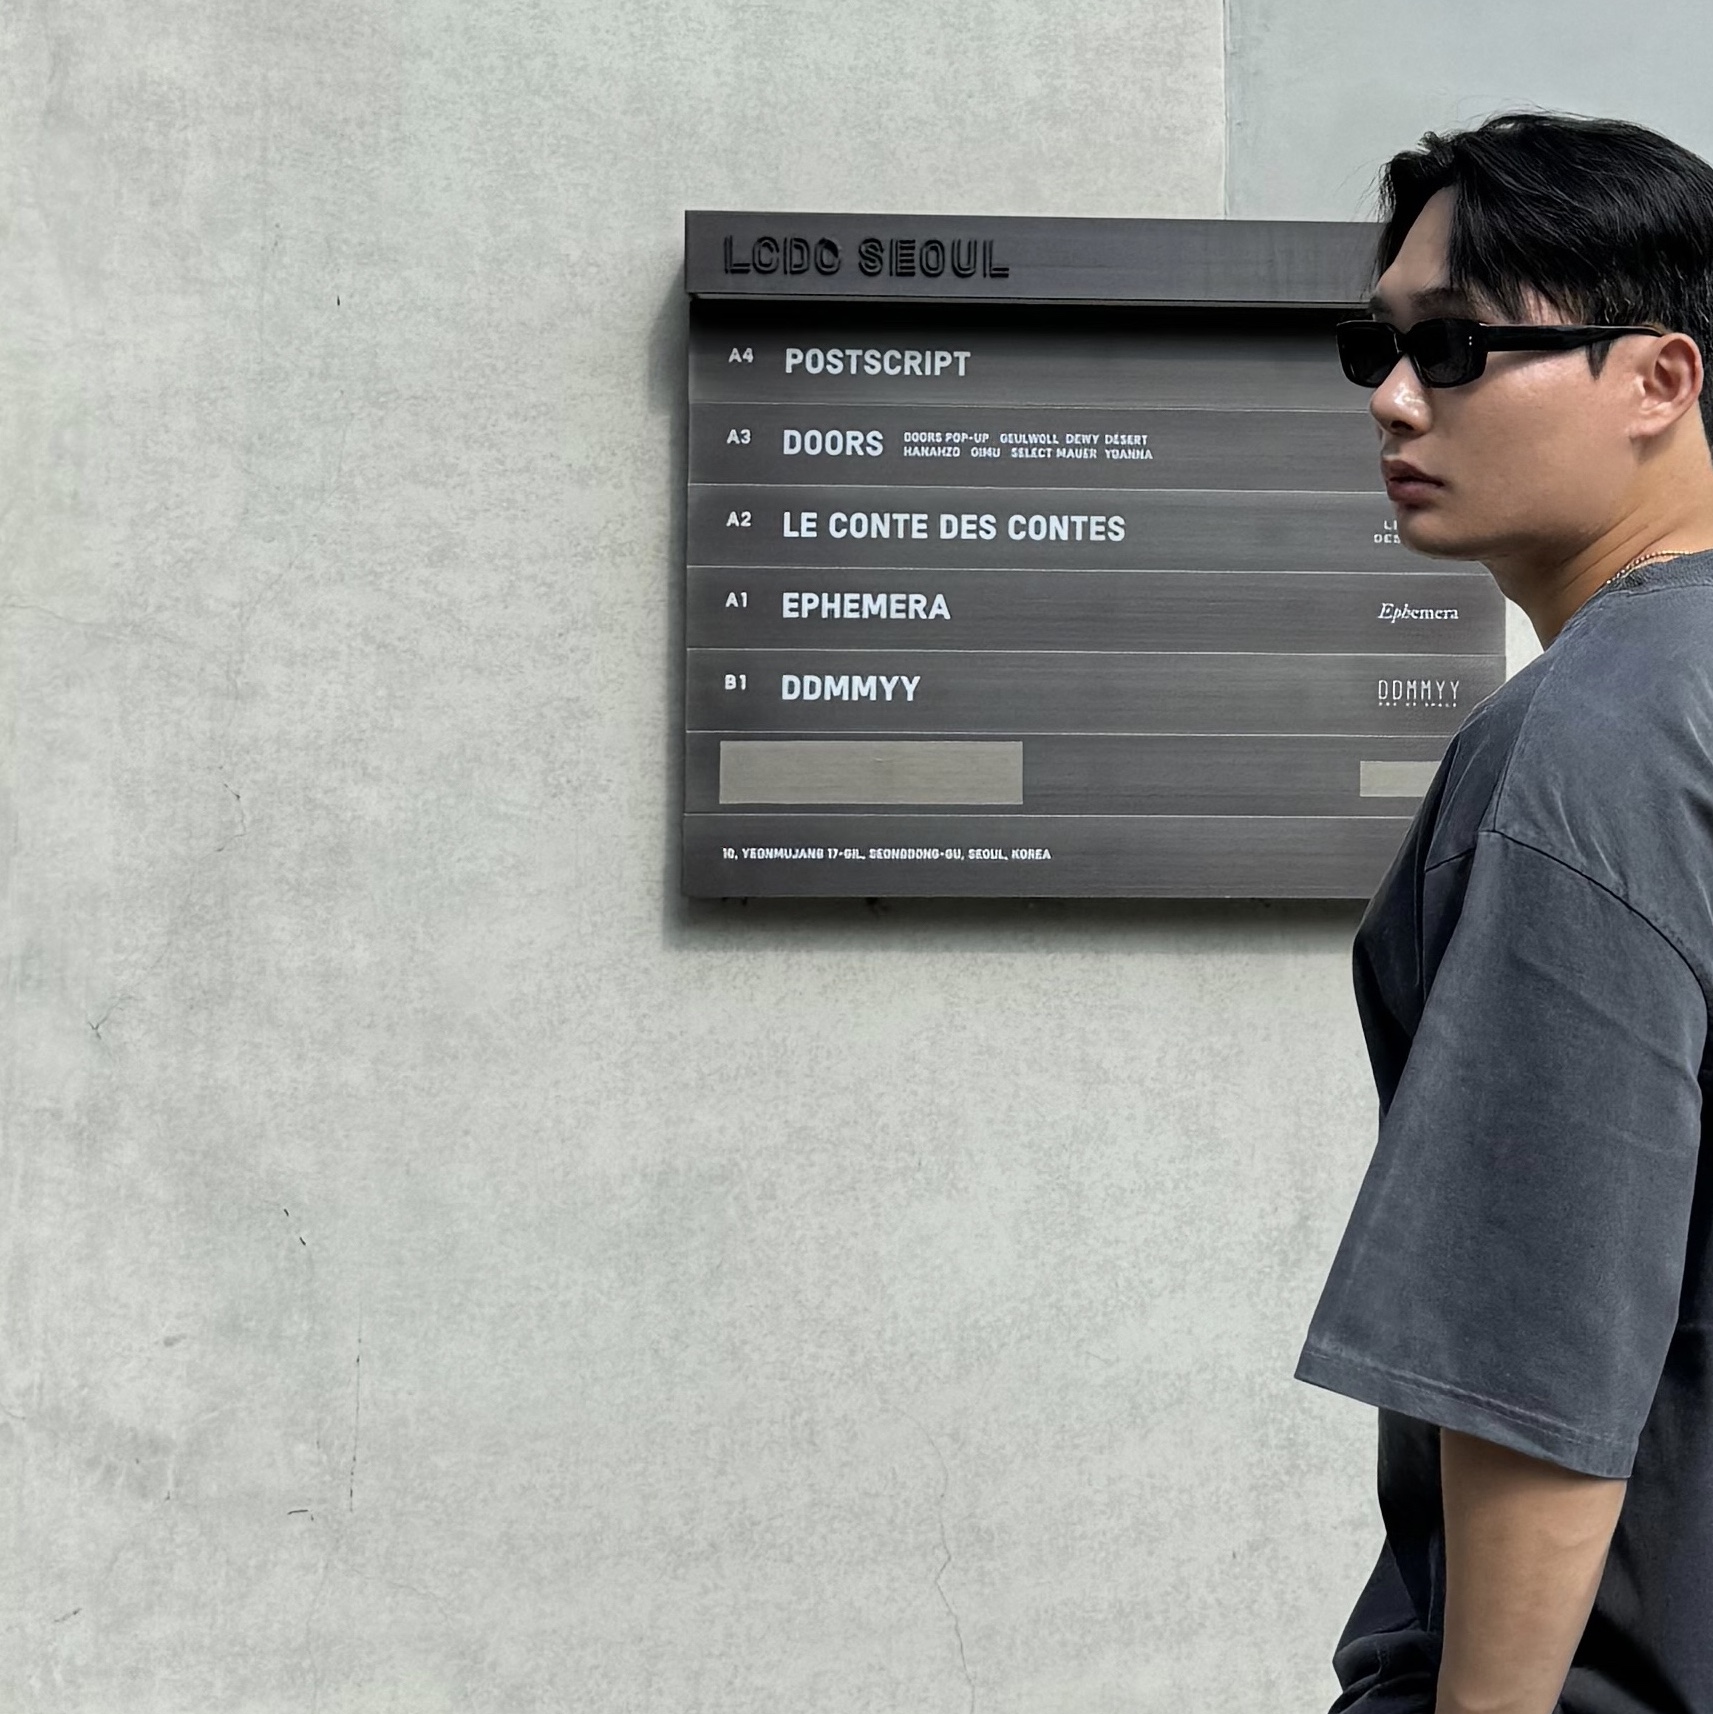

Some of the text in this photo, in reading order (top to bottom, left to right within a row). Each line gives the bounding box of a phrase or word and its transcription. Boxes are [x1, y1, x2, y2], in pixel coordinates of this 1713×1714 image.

[858, 238, 1010, 279] SEOUL
[728, 347, 971, 377] A4 POSTSCRIPT
[726, 428, 884, 457] A3 DOORS
[903, 431, 943, 443] DOORS
[944, 432, 990, 444] POP-UP
[1065, 433, 1100, 445] DEWY
[1011, 447, 1053, 459] SELECT
[725, 510, 1126, 542] A2 LE CONTE DES CONTES
[725, 591, 951, 620] A1 EPHEMERA
[1377, 602, 1459, 624] Ephemera
[724, 673, 921, 702] B1 DDMMYY
[1377, 679, 1460, 701] DDMMYY
[722, 847, 739, 861] 10,
[741, 847, 824, 860] YEONMUJANG
[967, 848, 1009, 861] SEOUL,
[1011, 848, 1052, 861] KOREA
